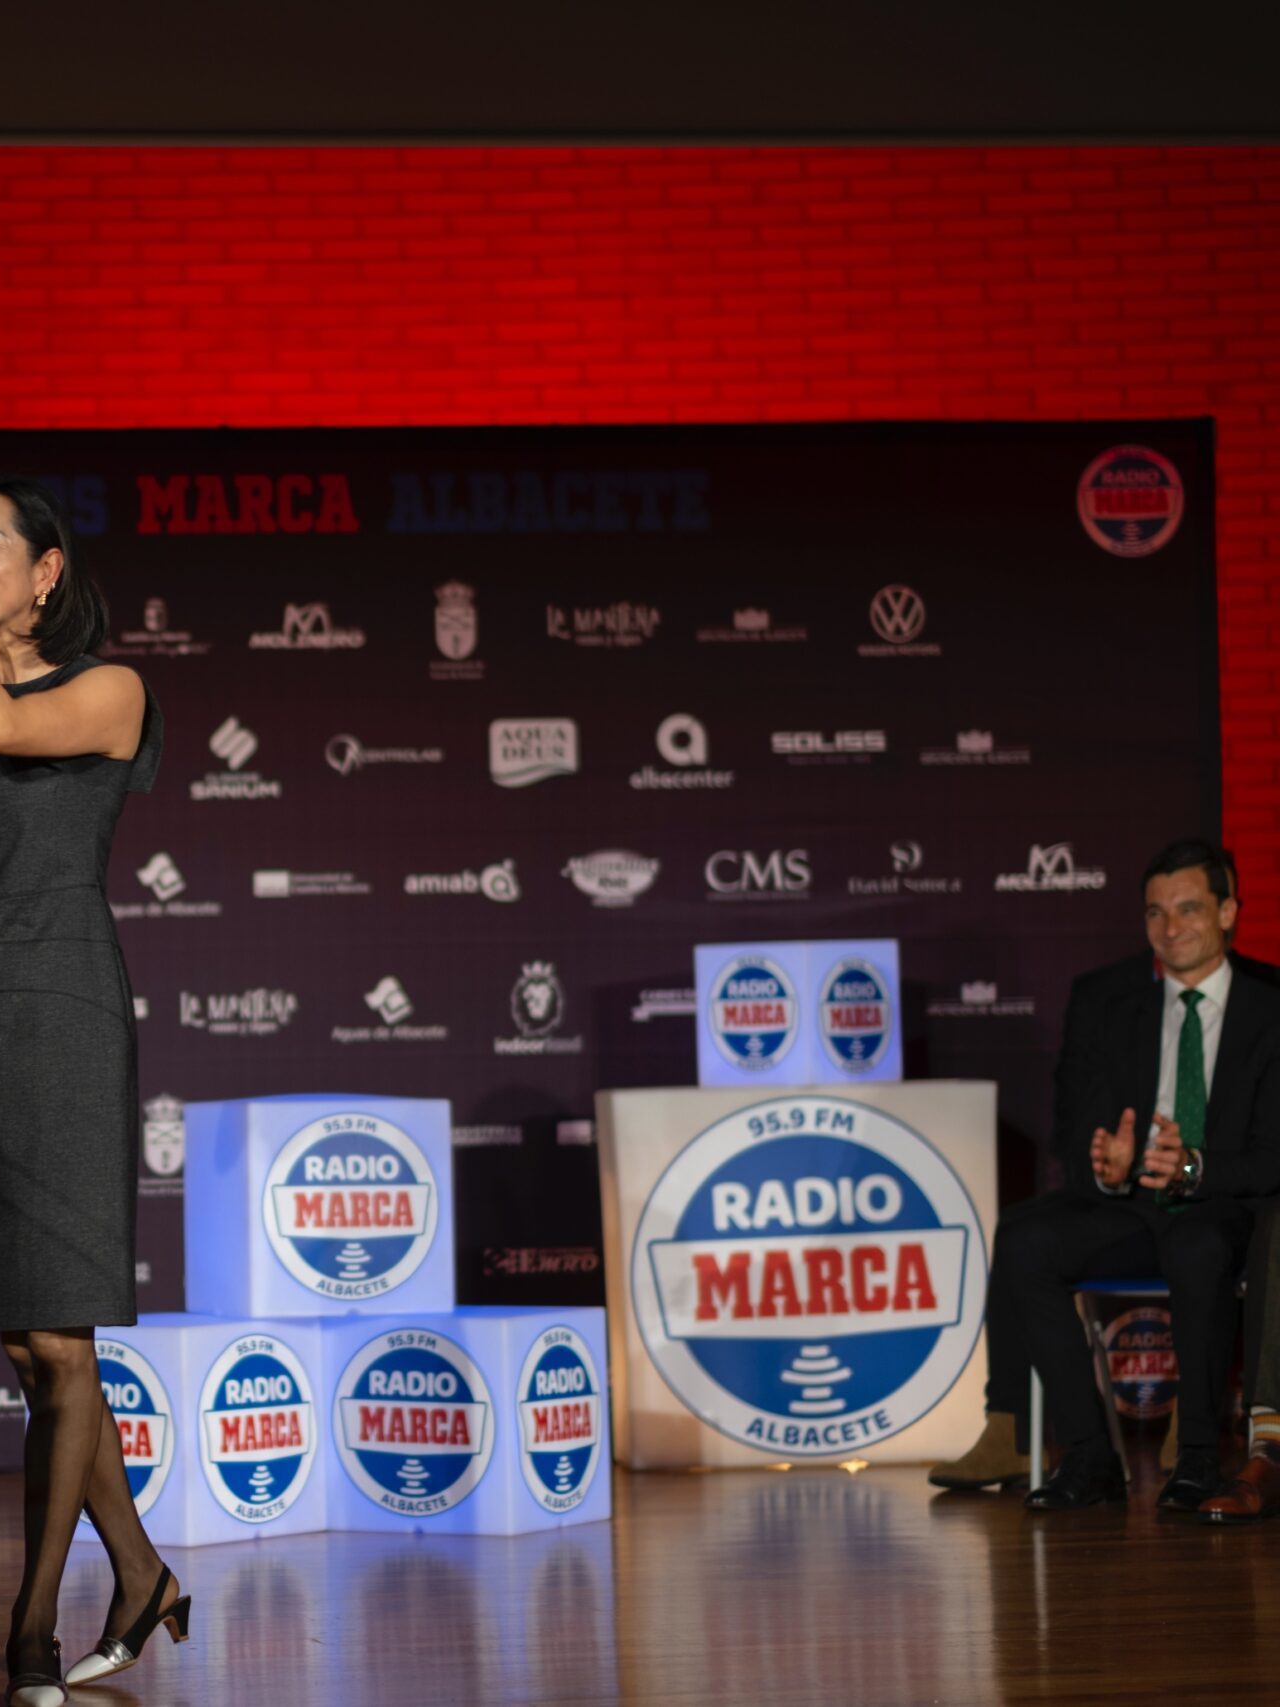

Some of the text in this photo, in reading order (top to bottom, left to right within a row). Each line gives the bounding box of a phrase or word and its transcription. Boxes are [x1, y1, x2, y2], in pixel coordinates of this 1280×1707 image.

[135, 472, 361, 535] MARCA
[386, 470, 711, 535] ALBACETE
[498, 728, 568, 748] AQUA
[770, 730, 887, 754] SOLISS
[501, 747, 567, 763] DEUS
[628, 767, 735, 790] albacenter
[404, 869, 479, 894] amiab
[705, 848, 812, 893] CMS
[726, 978, 778, 998] RADIO
[833, 981, 877, 999] RADIO
[723, 1003, 787, 1028] MARCA
[830, 1005, 882, 1029] MARCA
[323, 1119, 378, 1133] 95.9 FM
[747, 1108, 856, 1139] 95.9 FM
[304, 1154, 400, 1182] RADIO
[293, 1191, 414, 1229] MARCA
[712, 1173, 903, 1232] RADIO
[315, 1277, 390, 1297] ALBACETE
[692, 1242, 938, 1323] MARCA
[257, 1340, 275, 1352] FM
[387, 1333, 437, 1349] 95.9 FM
[225, 1375, 292, 1406] RADIO
[368, 1370, 458, 1398] RADIO
[535, 1366, 586, 1396] RADIO
[100, 1381, 142, 1411] DIO
[220, 1411, 303, 1454] MARCA
[358, 1406, 472, 1446] MARCA
[532, 1402, 592, 1444] MARCA
[745, 1408, 892, 1448] ALBACETE
[234, 1499, 287, 1520] ALBACETE
[380, 1493, 449, 1513] ALBACETE
